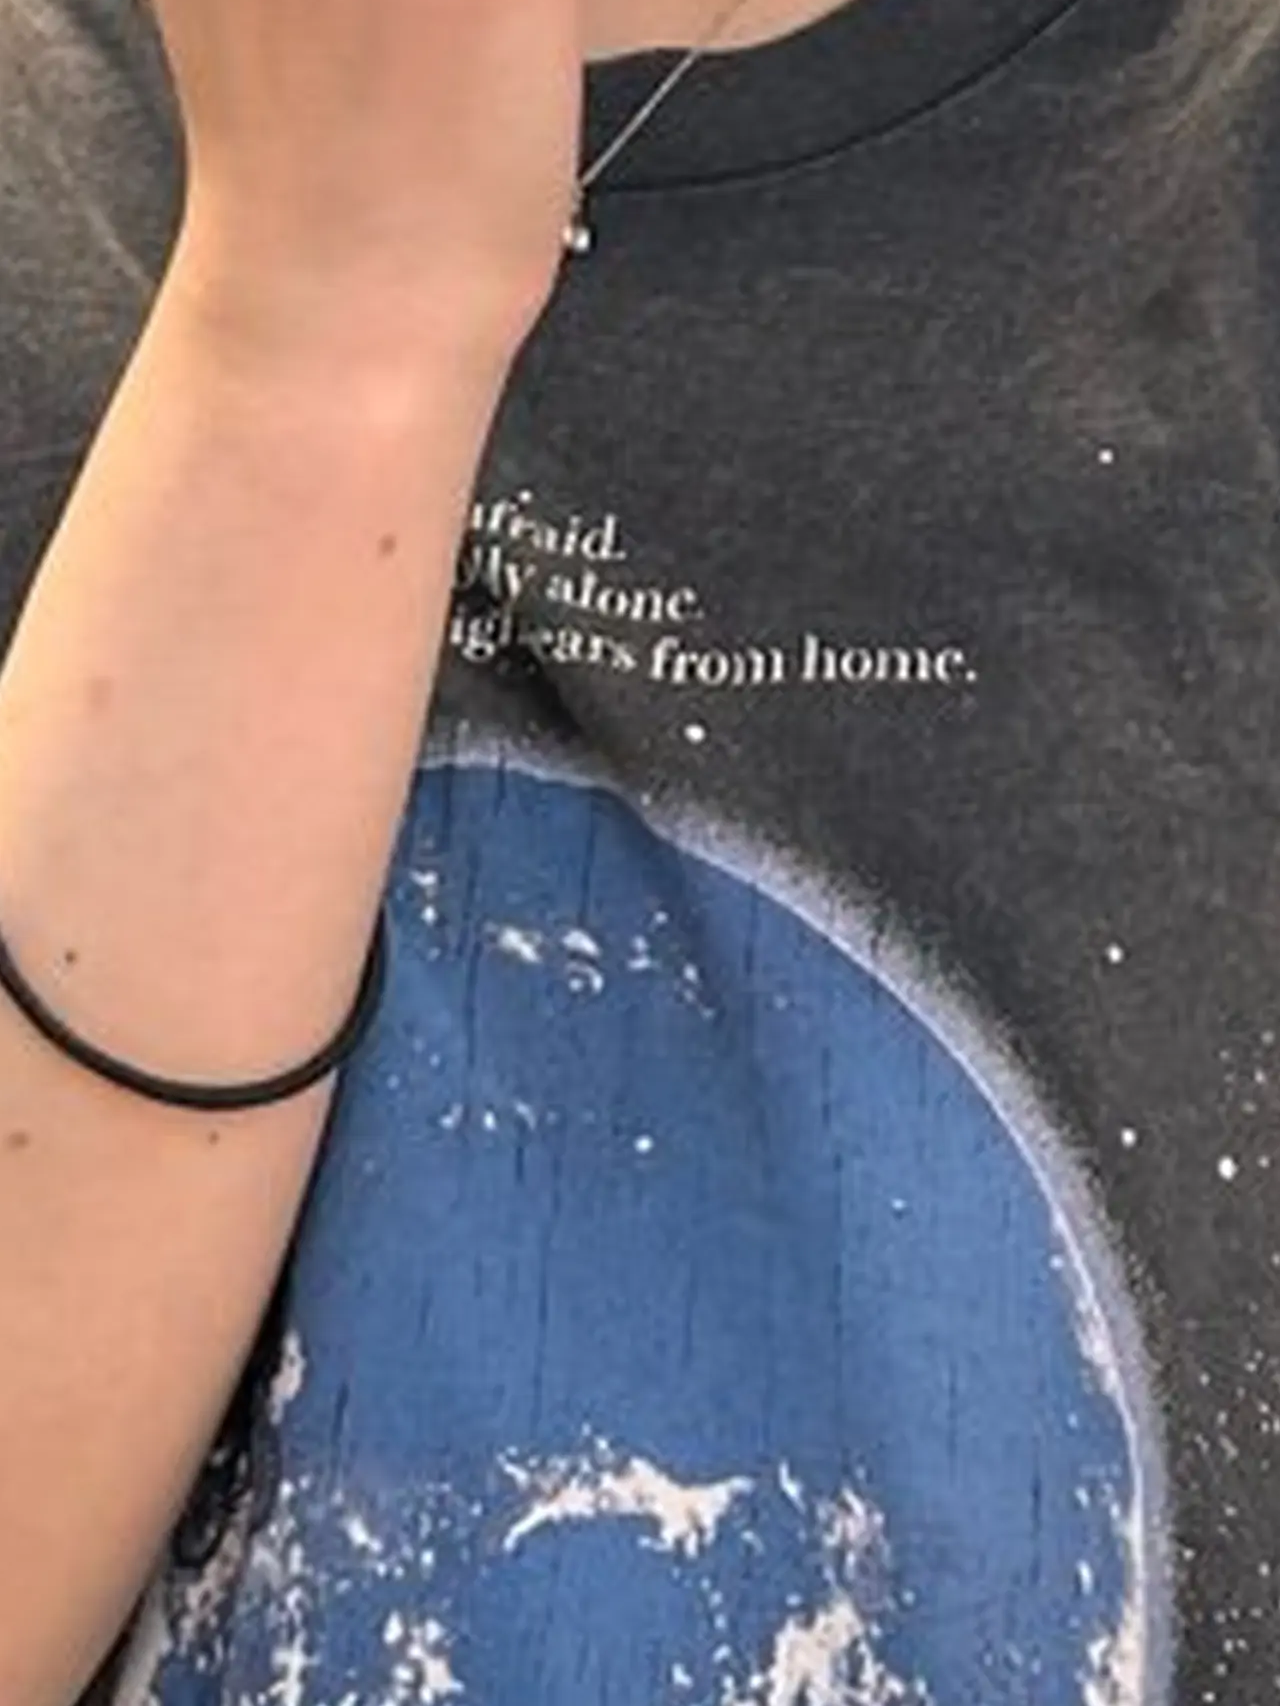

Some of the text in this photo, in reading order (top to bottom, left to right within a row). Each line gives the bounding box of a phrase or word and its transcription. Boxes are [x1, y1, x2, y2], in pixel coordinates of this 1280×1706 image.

[544, 566, 705, 622] alone.
[648, 635, 784, 685] from
[801, 633, 978, 683] home.
